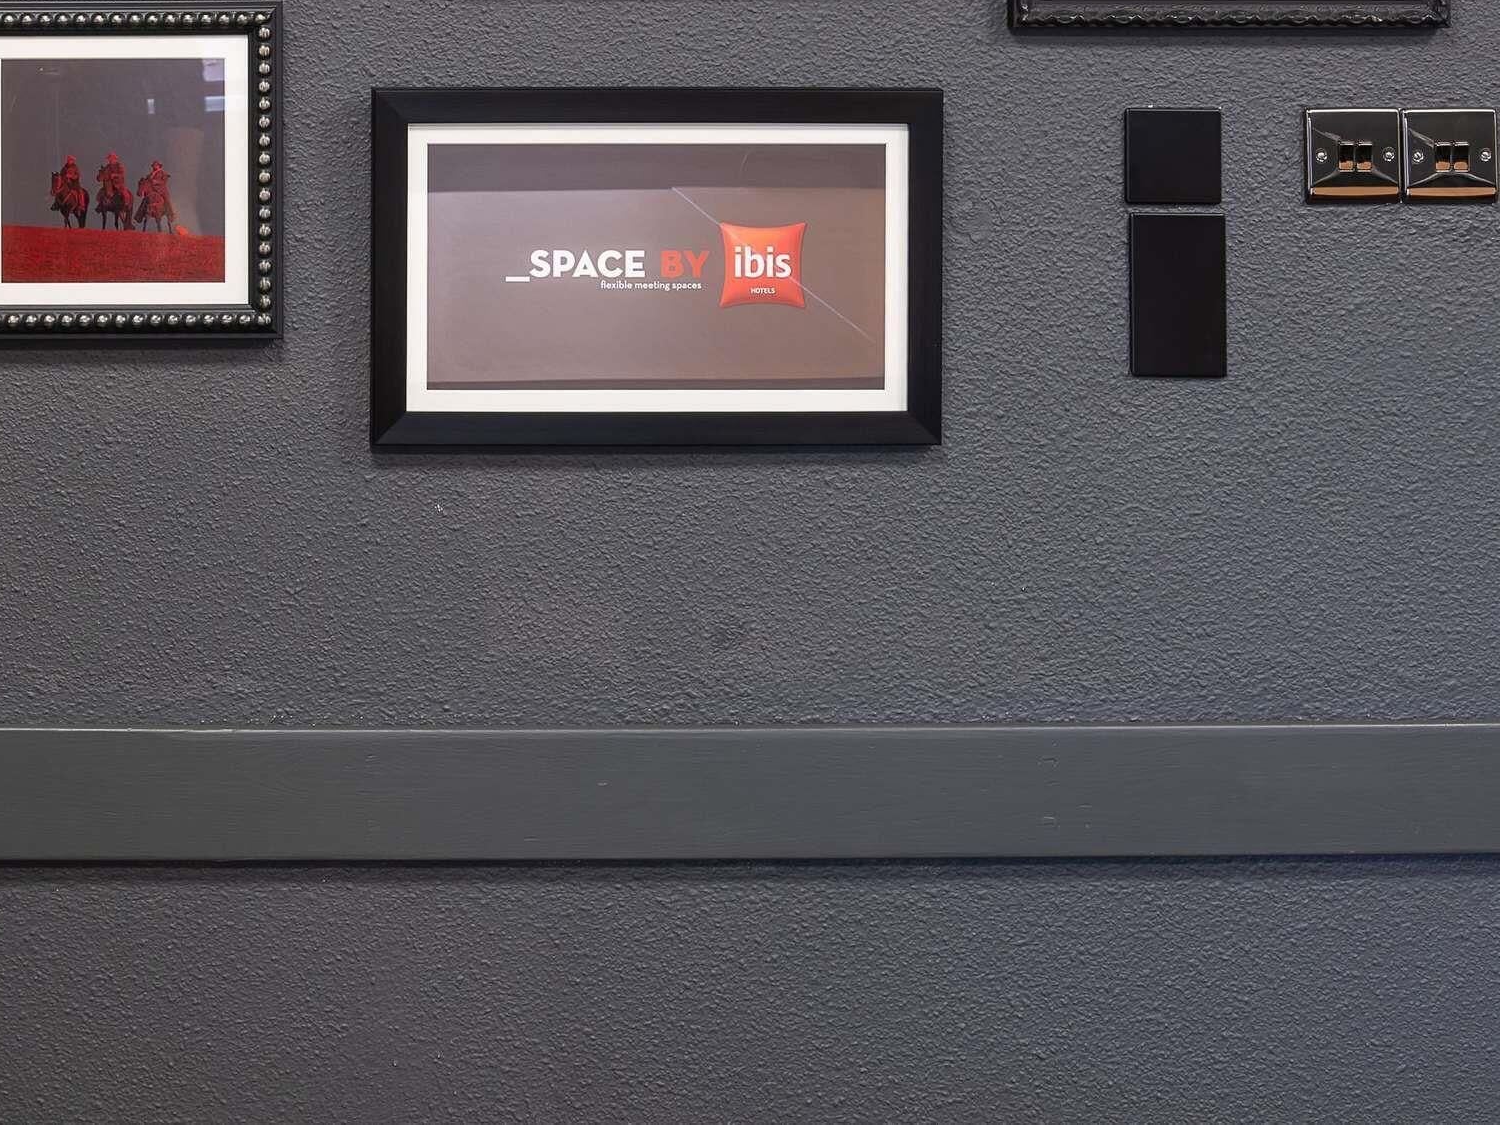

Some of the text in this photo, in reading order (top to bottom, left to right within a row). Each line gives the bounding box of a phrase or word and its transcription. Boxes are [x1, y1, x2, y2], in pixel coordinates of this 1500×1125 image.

[660, 250, 709, 279] BY
[734, 246, 792, 278] ibis
[600, 280, 703, 292] flexible meeting spaces
[750, 287, 776, 295] HOTELS
